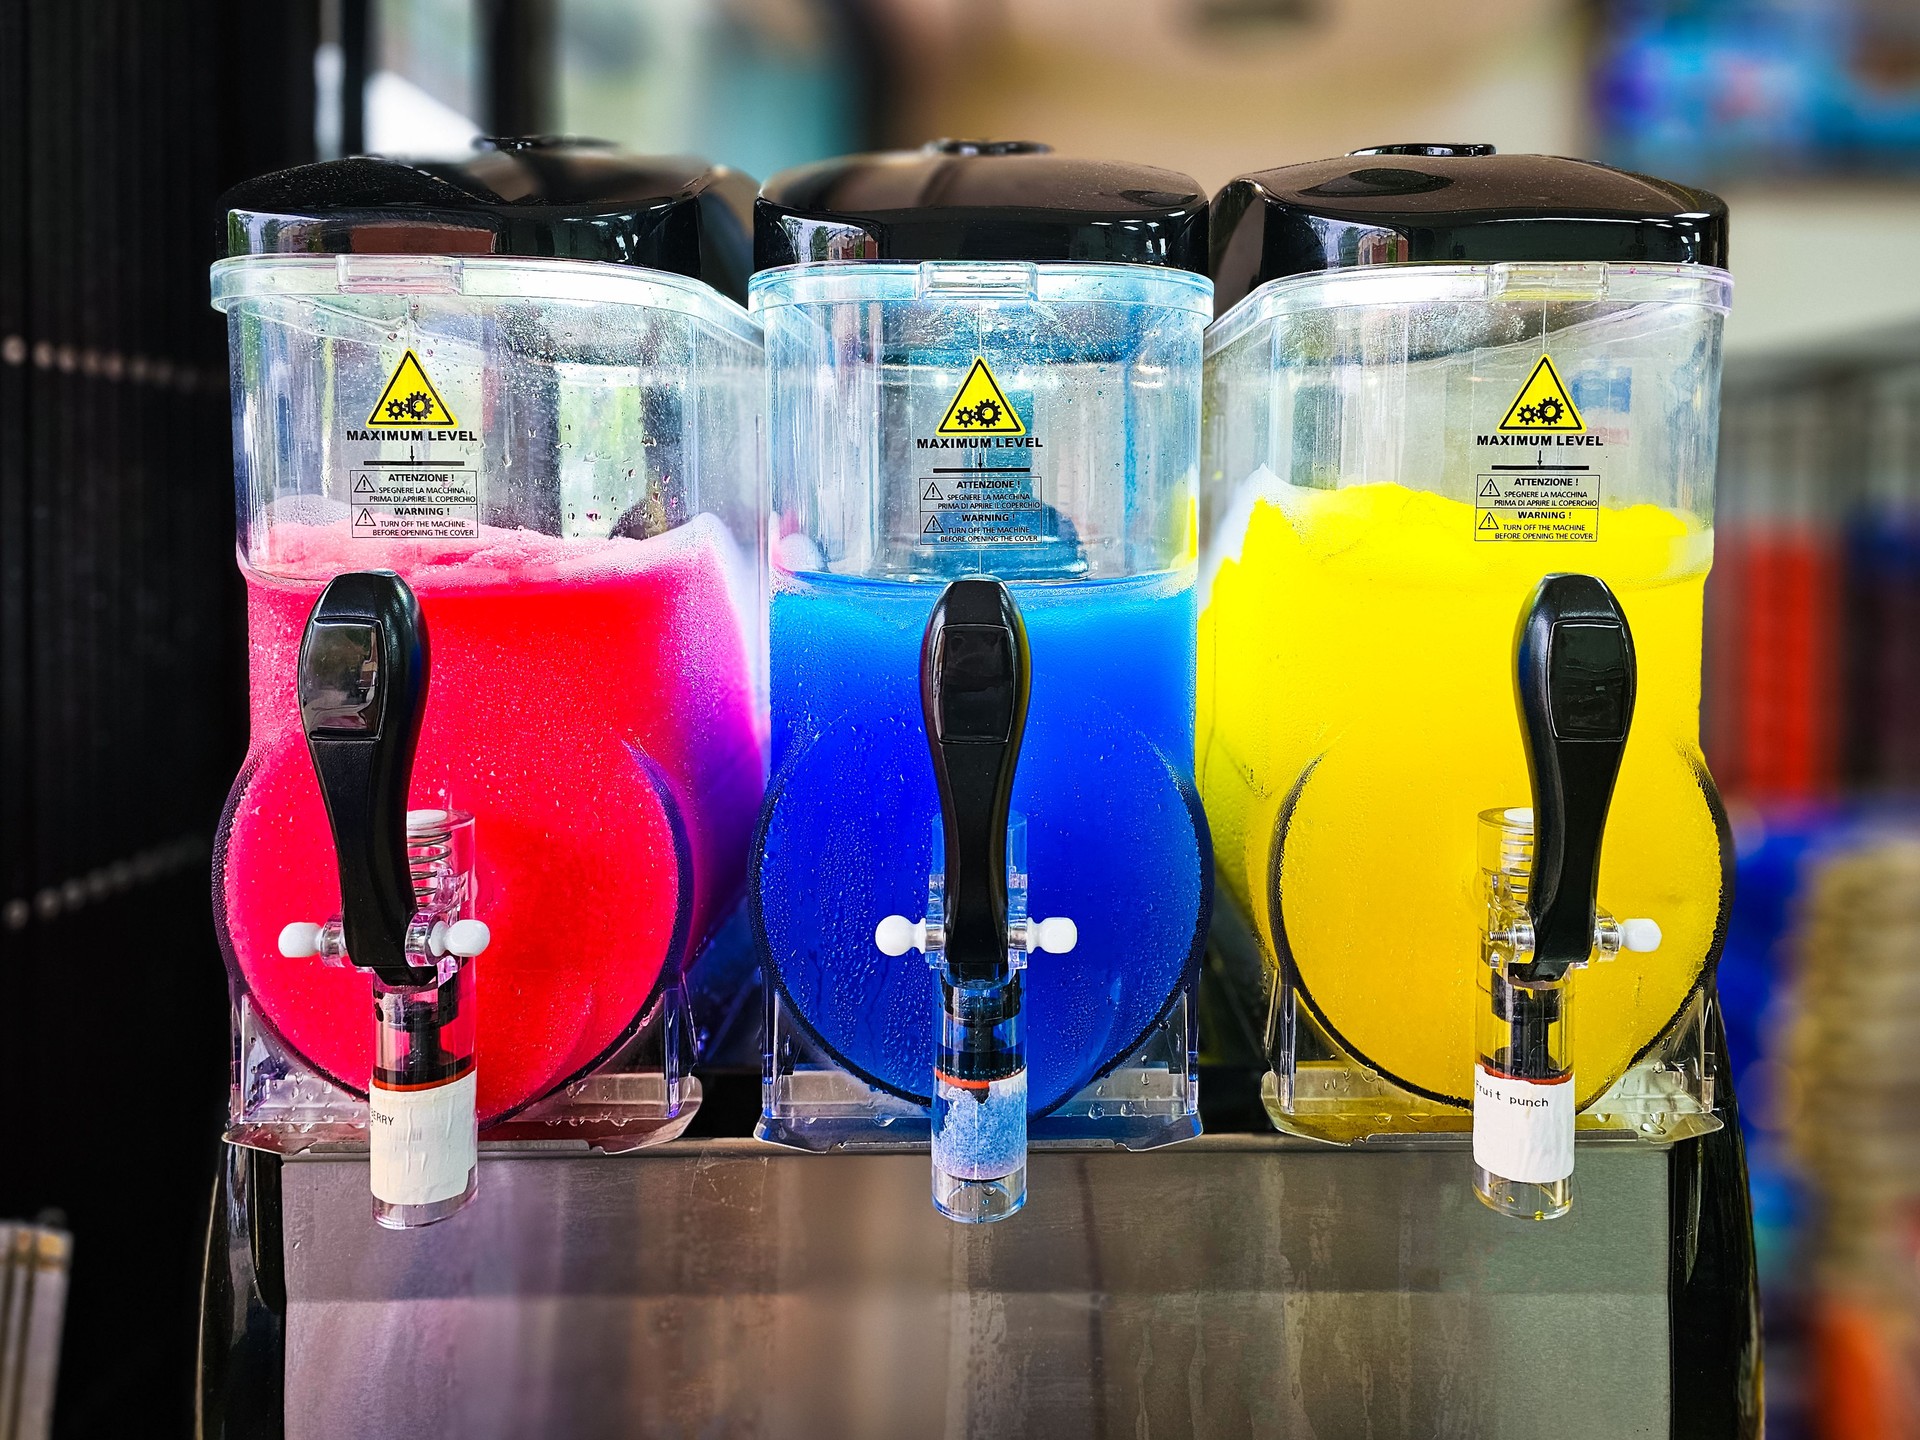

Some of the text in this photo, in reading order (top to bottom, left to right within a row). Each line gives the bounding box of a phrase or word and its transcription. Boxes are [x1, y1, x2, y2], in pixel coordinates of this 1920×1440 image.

[347, 431, 477, 441] MAXIMUM LEVEL
[1477, 436, 1603, 446] MAXIMUM LEVEL
[917, 438, 1043, 448] MAXIMUM LEVEL
[1514, 478, 1572, 486] ATTENZIONE
[1510, 1097, 1549, 1107] punch
